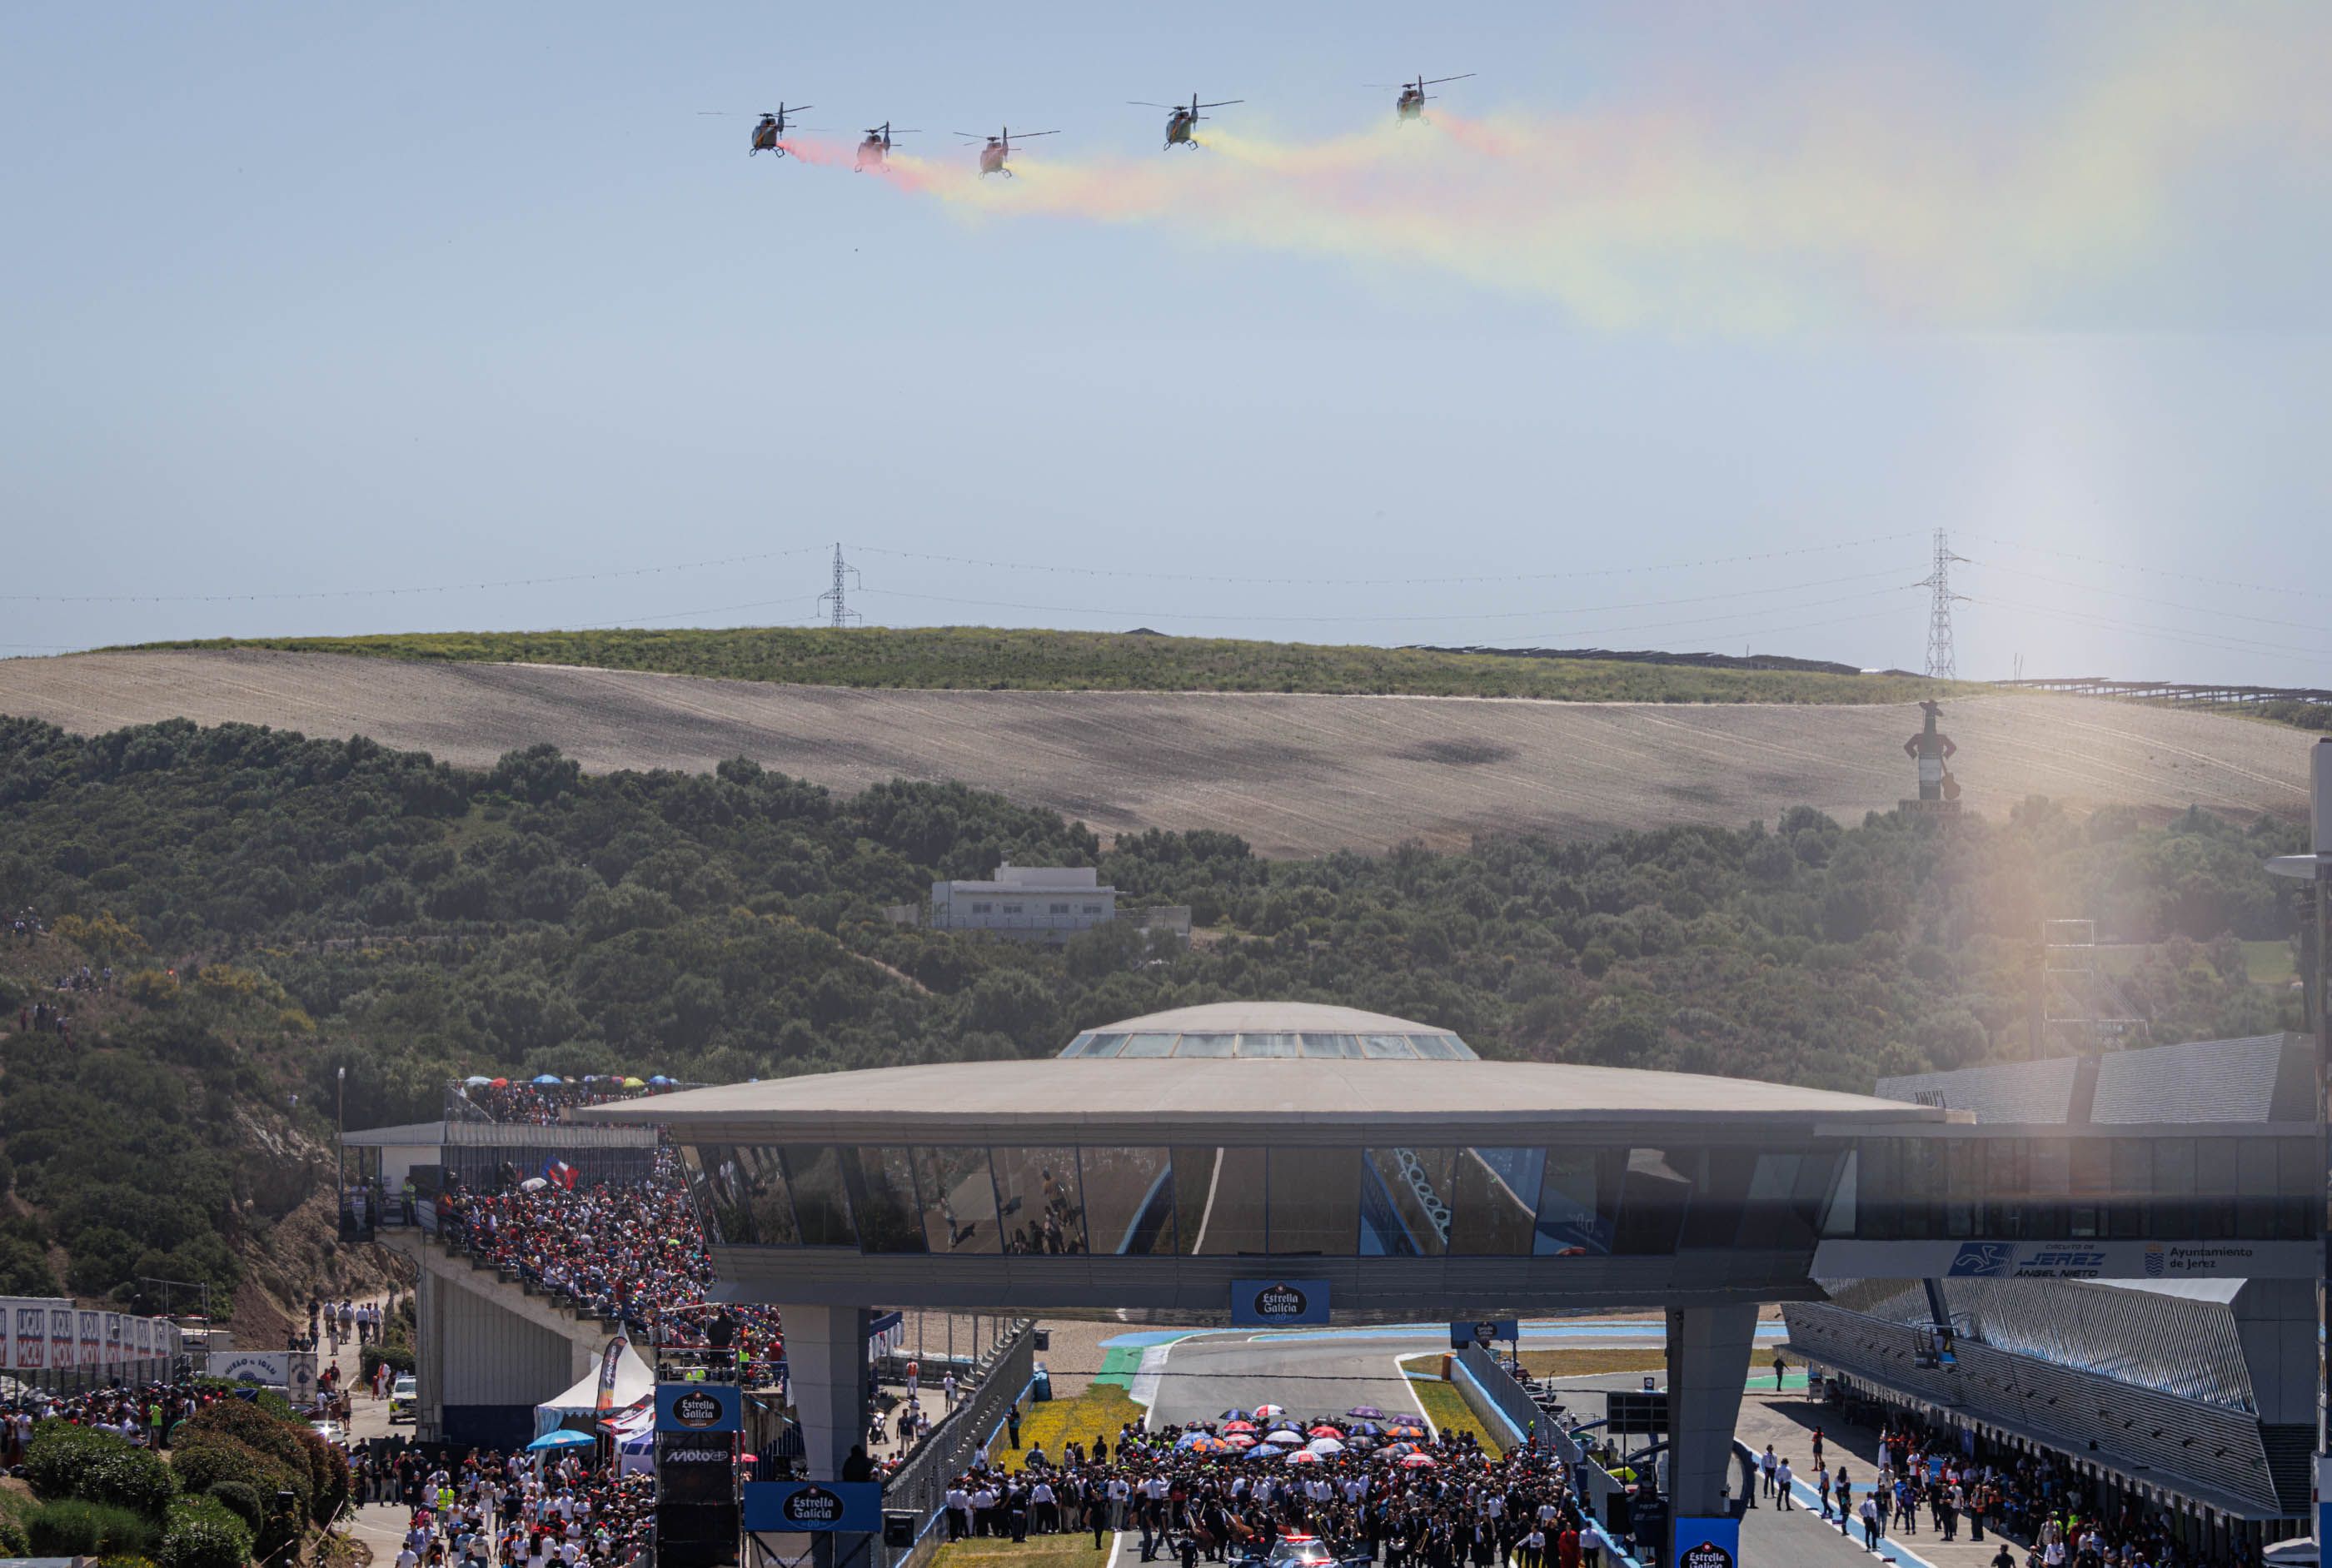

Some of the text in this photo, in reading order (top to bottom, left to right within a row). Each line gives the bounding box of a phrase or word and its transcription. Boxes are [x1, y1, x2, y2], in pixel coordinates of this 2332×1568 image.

[2170, 1247, 2253, 1258] Ayuntamiento
[2019, 1252, 2106, 1266] JEREZ
[2170, 1259, 2216, 1271] de Jerez
[2013, 1267, 2099, 1277] ÁNGEL NIETO
[1263, 1293, 1299, 1303] Estrella
[1263, 1302, 1298, 1313] Galicia
[18, 1311, 43, 1337] LIQUI
[52, 1312, 72, 1338] LIQUI
[18, 1340, 43, 1366] MOLY
[52, 1342, 73, 1366] MOLY
[681, 1400, 715, 1409] Estrella
[682, 1408, 713, 1419] Galicia
[665, 1451, 729, 1462] MotoGP
[793, 1496, 834, 1508] Estrella
[794, 1507, 832, 1519] Galicia
[1688, 1552, 1726, 1562] Estrella
